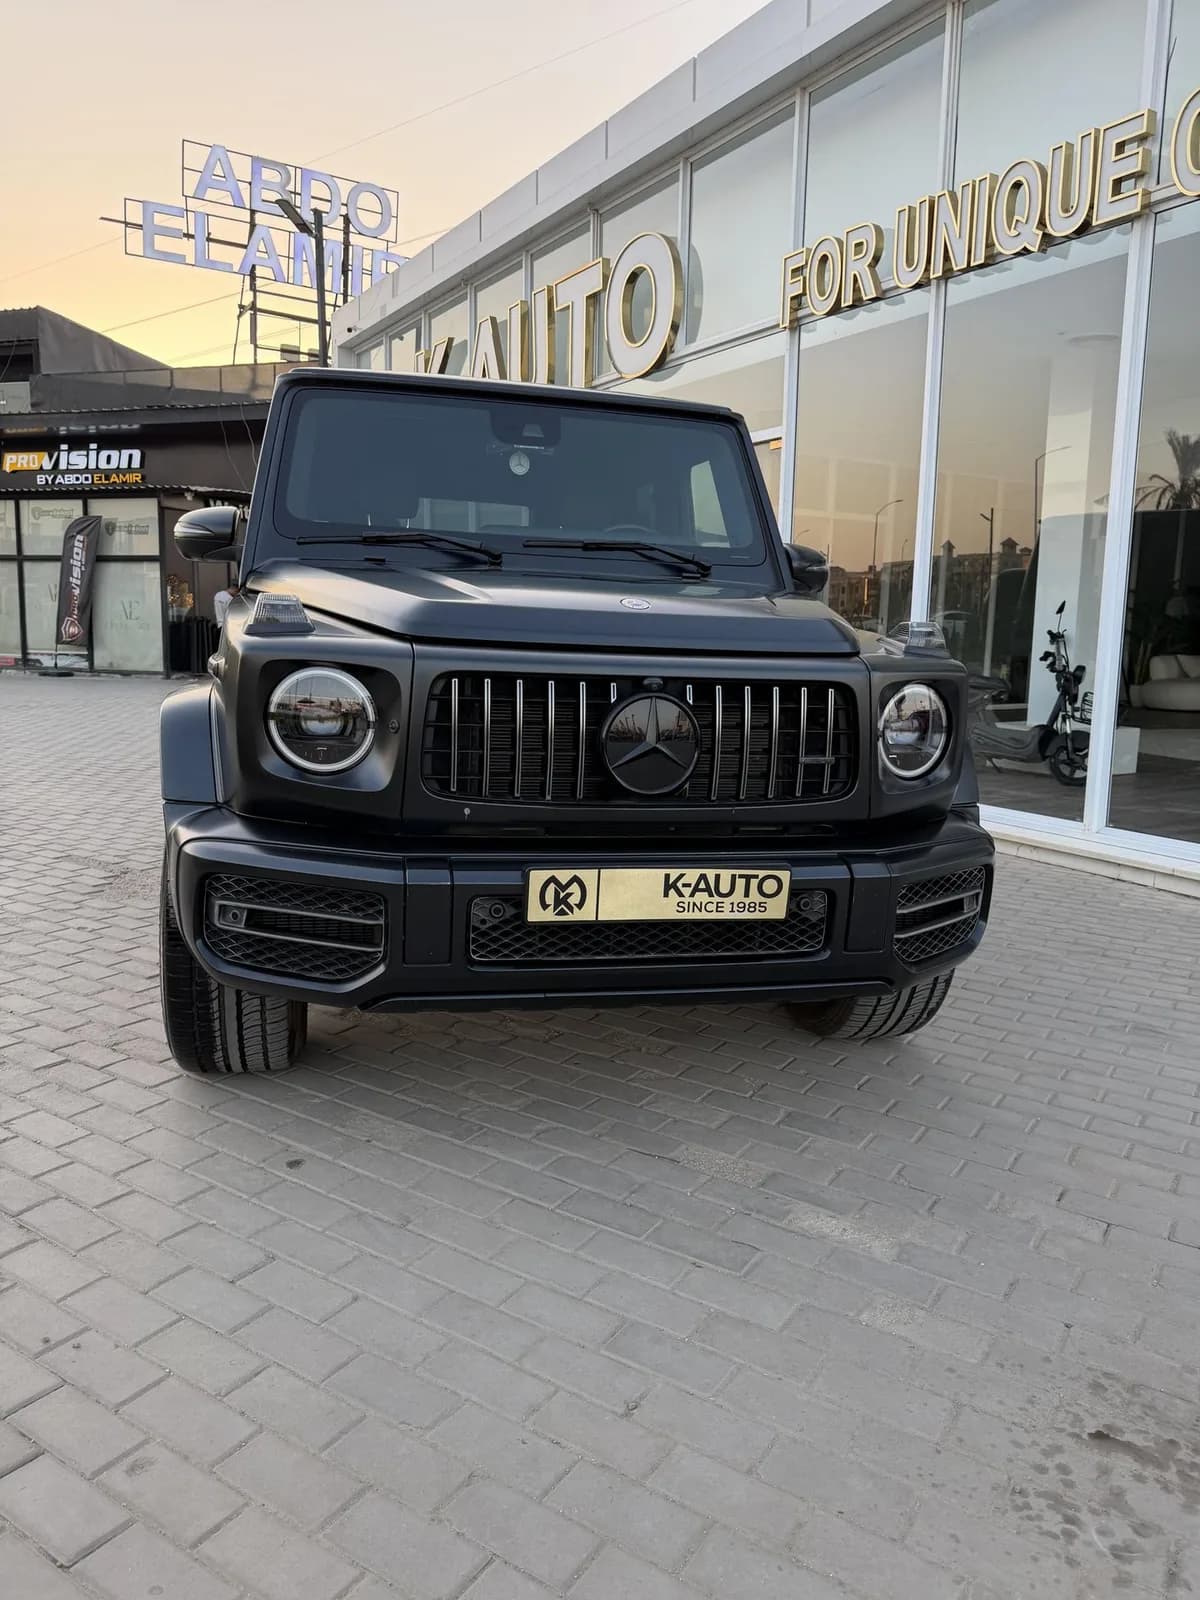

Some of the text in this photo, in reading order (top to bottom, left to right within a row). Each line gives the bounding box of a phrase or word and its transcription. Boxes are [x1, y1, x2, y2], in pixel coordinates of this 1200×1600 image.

[192, 143, 393, 239] ABDO
[780, 222, 883, 329] FOR
[892, 108, 1156, 289] UNIQUE
[36, 473, 54, 485] BY
[55, 473, 92, 485] ABDO
[662, 872, 784, 899] K-AUTO
[675, 901, 768, 914] SINCE 1985
